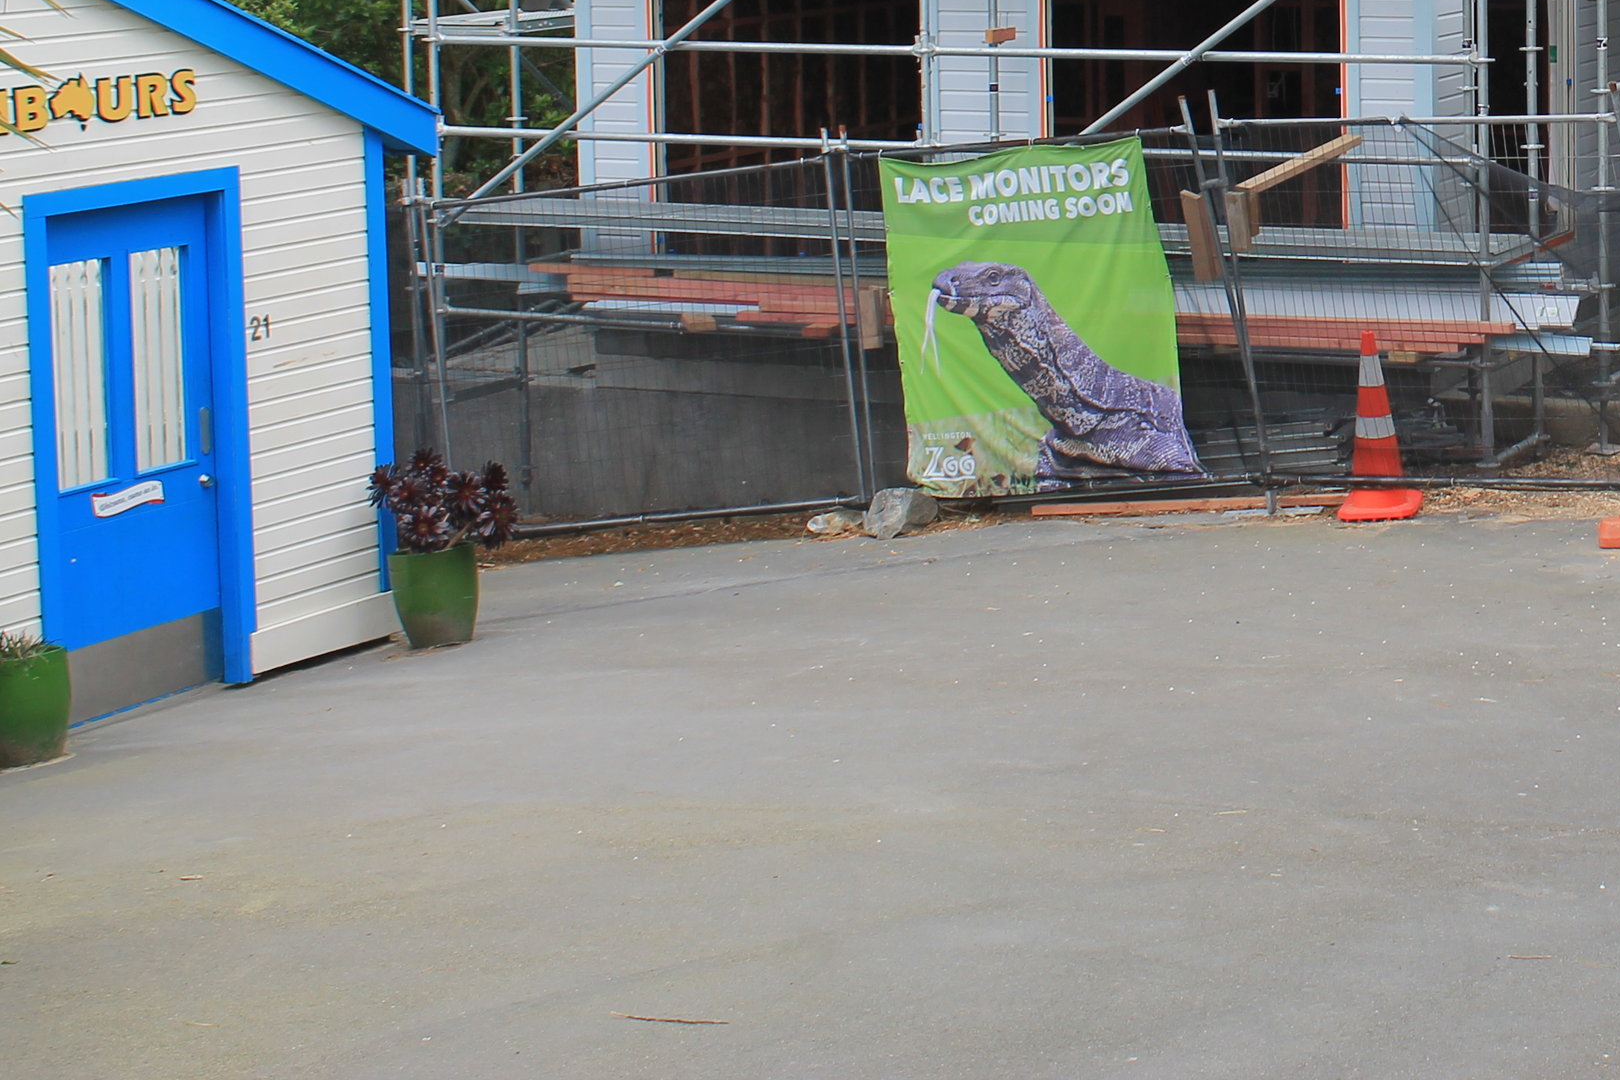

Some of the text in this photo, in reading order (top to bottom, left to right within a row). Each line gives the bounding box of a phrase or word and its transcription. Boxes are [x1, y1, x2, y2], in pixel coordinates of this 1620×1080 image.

[894, 158, 1129, 204] LACE MONITORS
[968, 191, 1133, 226] COMING SOON
[250, 314, 271, 342] 21
